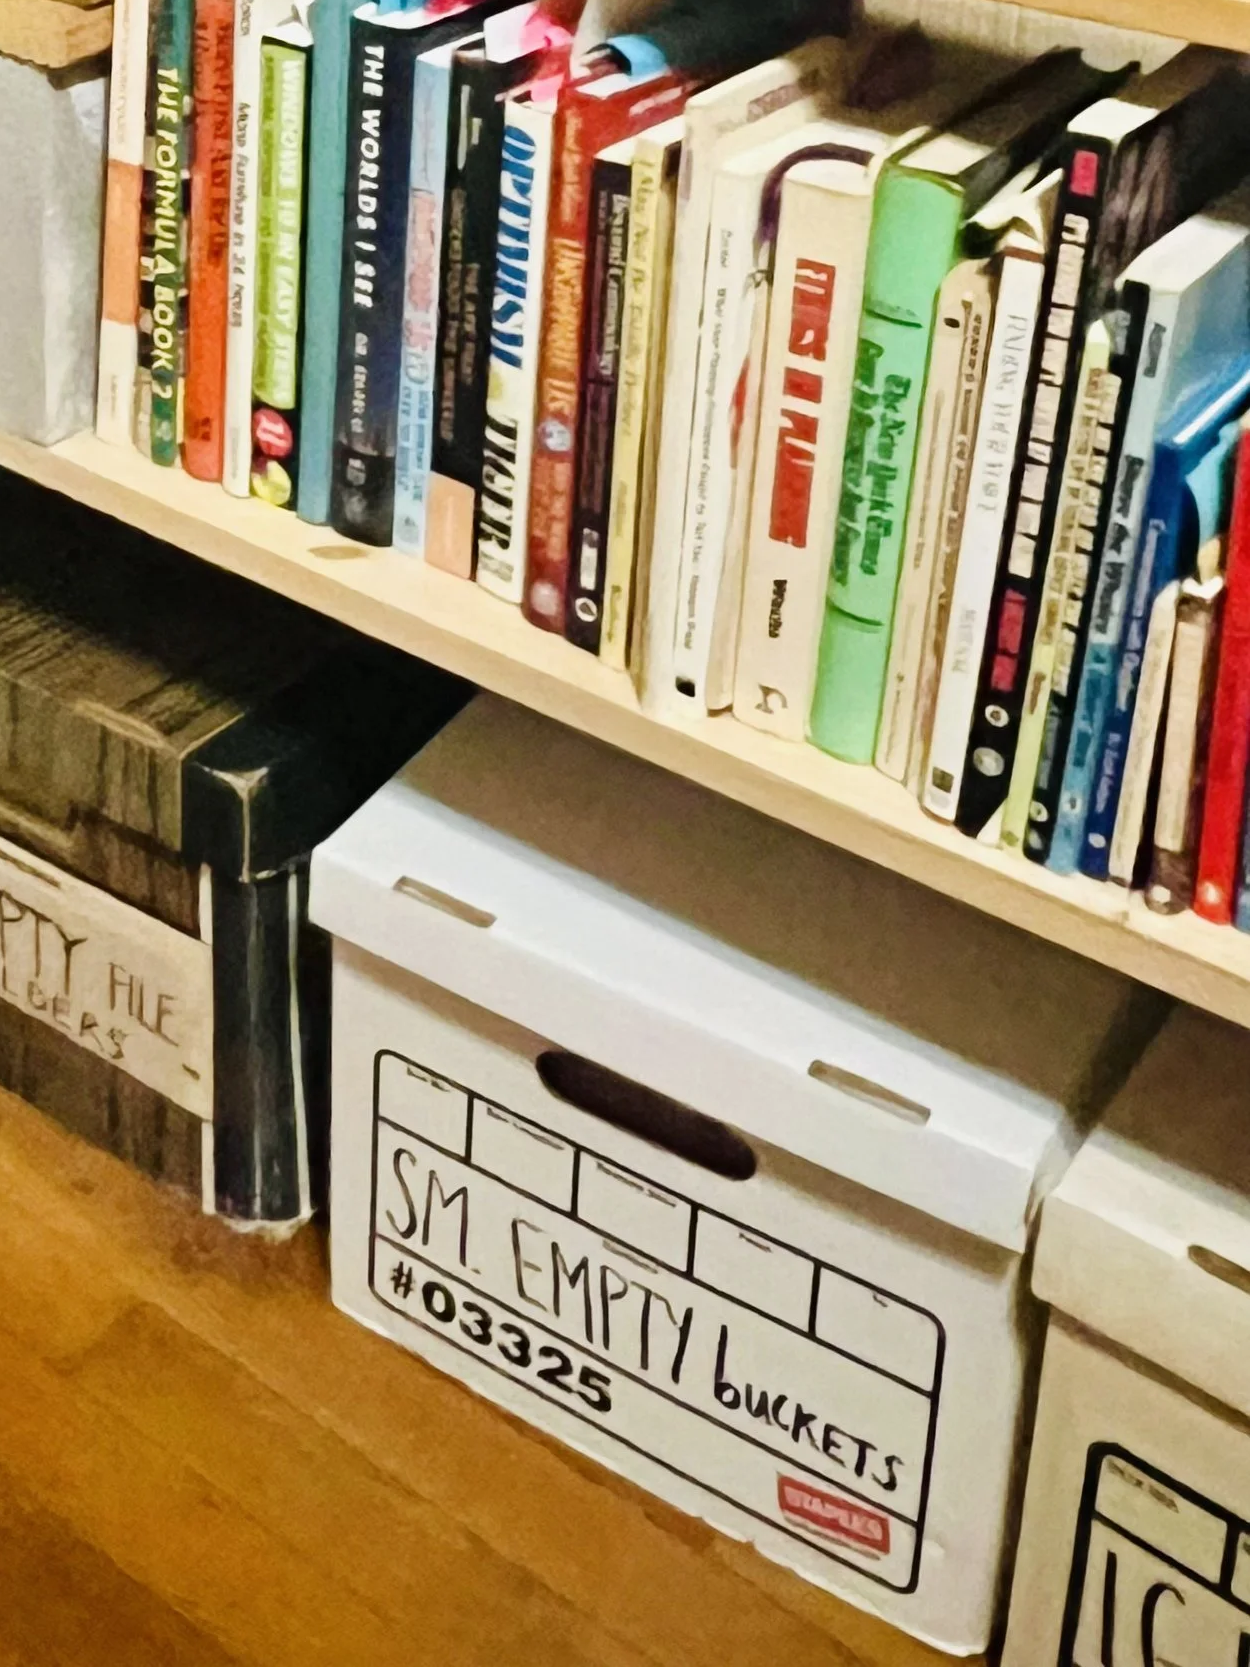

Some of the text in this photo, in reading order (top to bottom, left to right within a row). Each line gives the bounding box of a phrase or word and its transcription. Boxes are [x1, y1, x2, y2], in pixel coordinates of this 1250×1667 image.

[156, 67, 180, 125] THE
[278, 58, 302, 191] WINDOWS
[152, 130, 179, 276] FORMULA
[352, 43, 386, 308] THE WORLDS I SEE
[149, 284, 175, 371] BOOK
[478, 416, 520, 551] TIGER
[108, 962, 180, 1047] FILE
[389, 1259, 613, 1414] #03325
[511, 1217, 694, 1385] EMPTY
